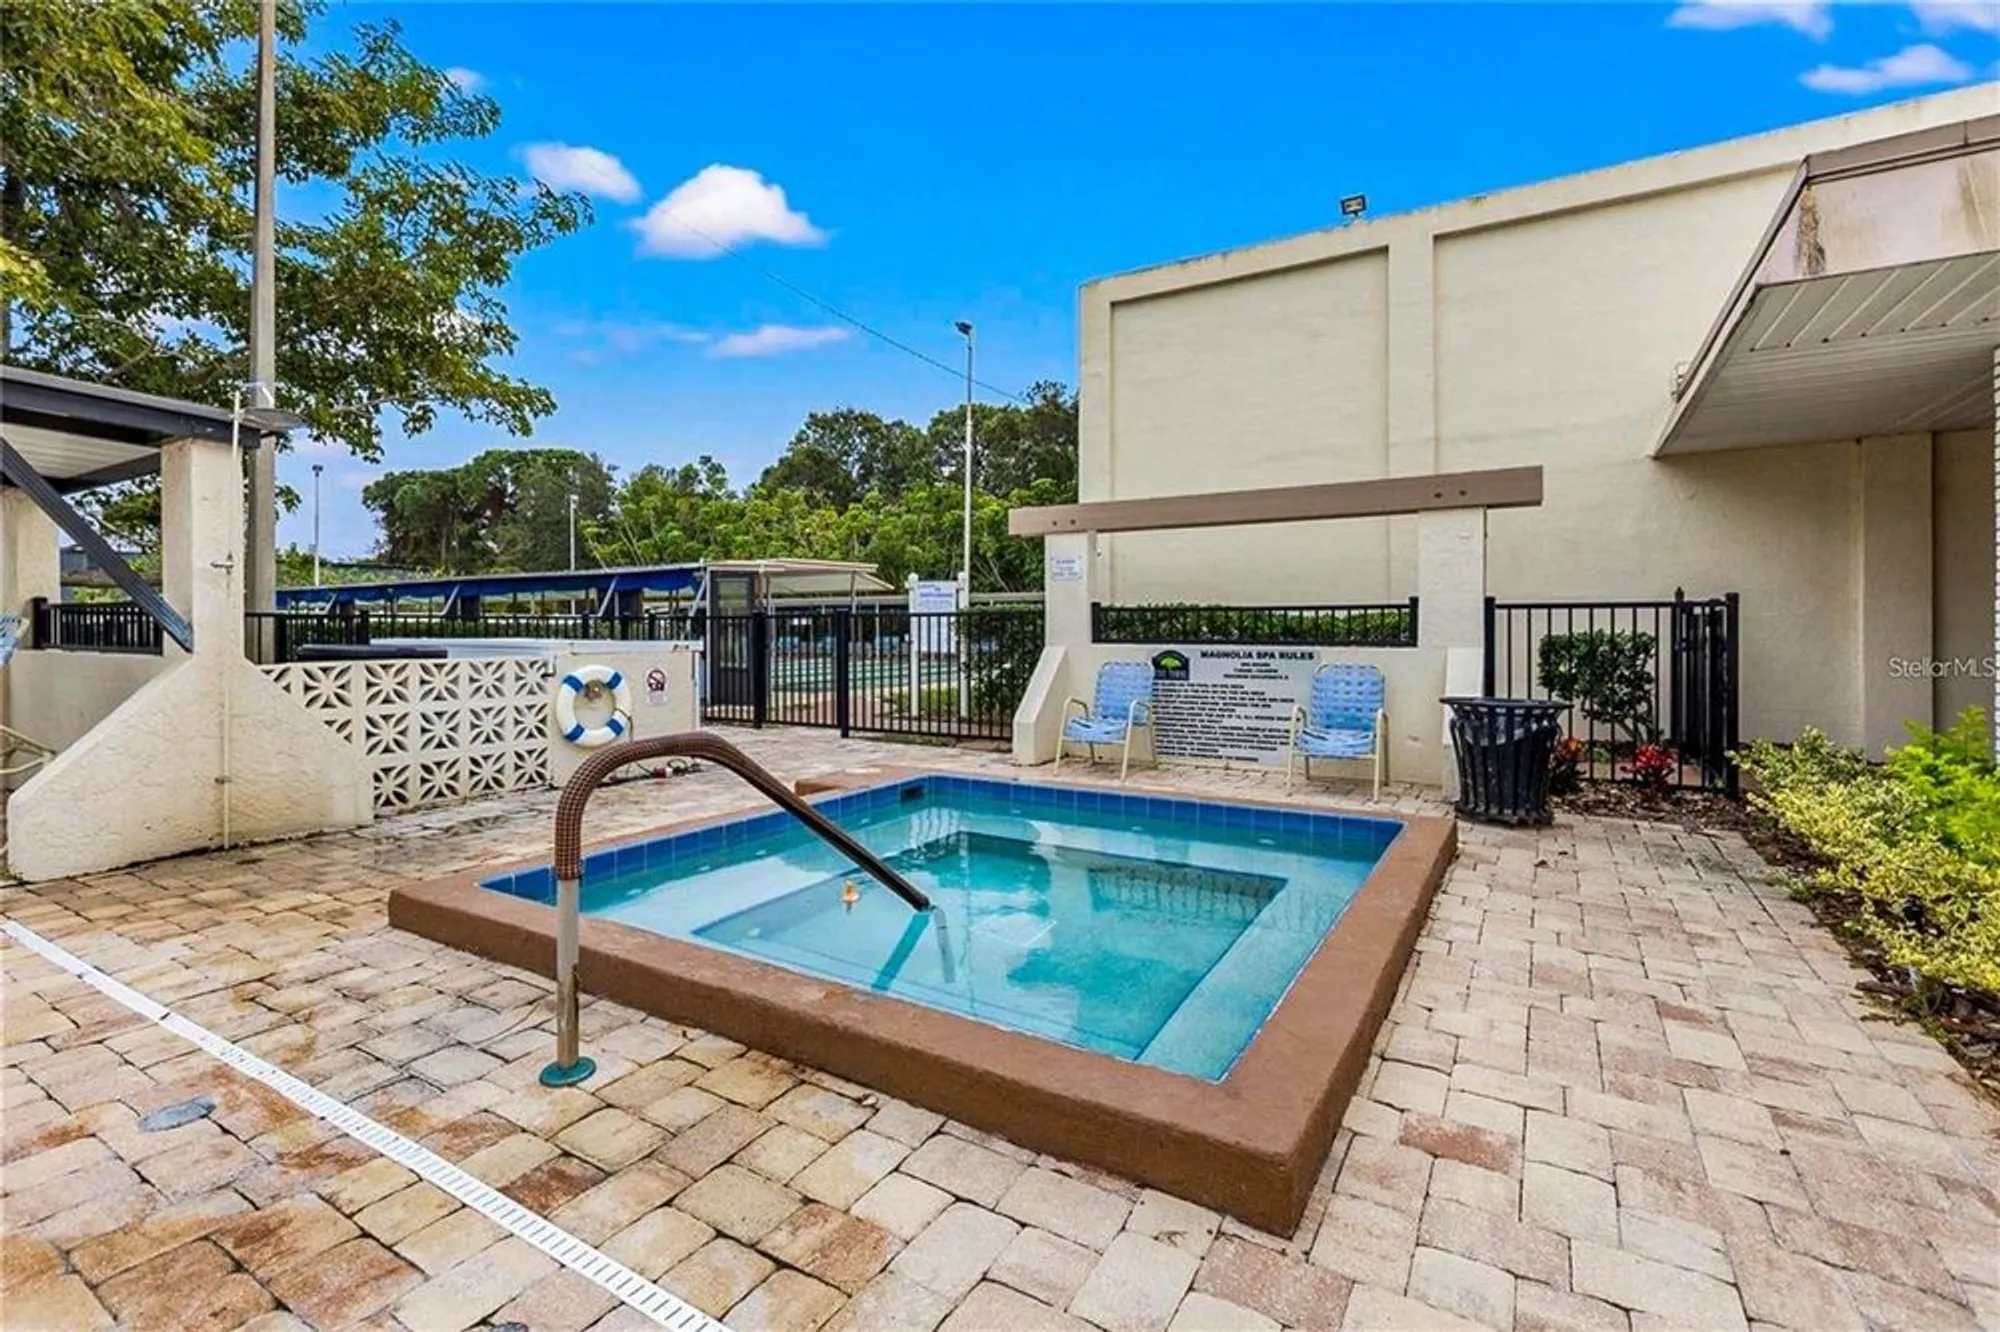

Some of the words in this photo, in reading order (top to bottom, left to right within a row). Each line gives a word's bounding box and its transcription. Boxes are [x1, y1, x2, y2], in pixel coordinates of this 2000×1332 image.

[1200, 650, 1254, 660] MAGNOLIA
[1256, 651, 1277, 660] SPA
[1279, 651, 1315, 661] RULES
